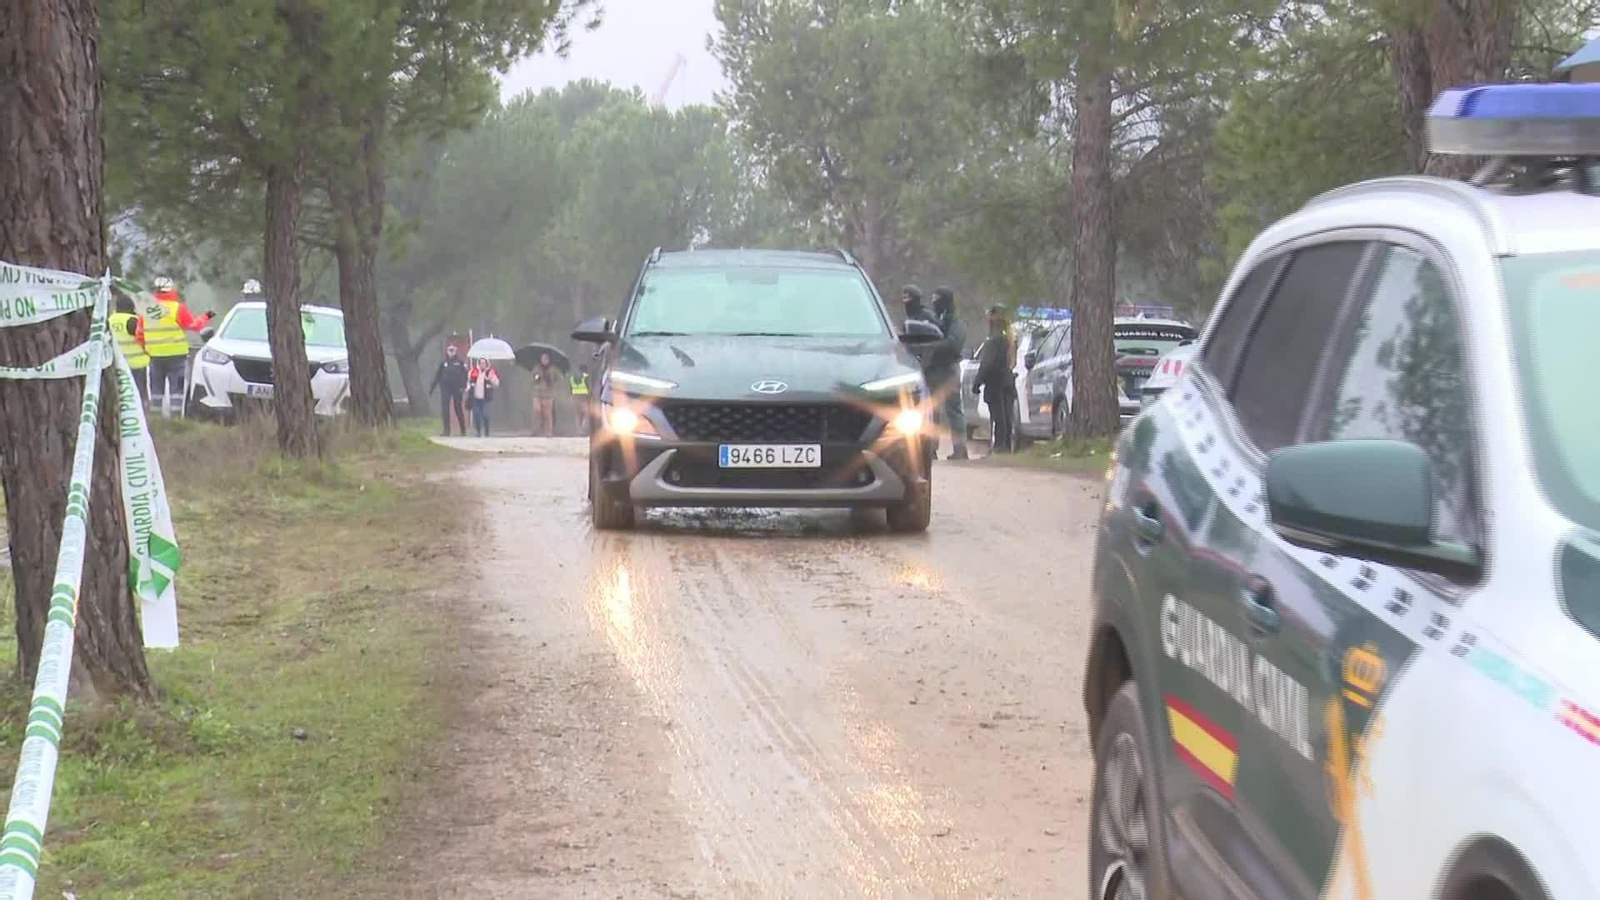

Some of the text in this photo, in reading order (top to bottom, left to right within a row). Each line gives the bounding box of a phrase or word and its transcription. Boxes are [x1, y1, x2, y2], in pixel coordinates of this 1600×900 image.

[0, 266, 21, 284] CIV
[15, 296, 36, 318] NO
[121, 417, 141, 437] NO
[730, 447, 816, 464] 9466 LZC
[127, 452, 148, 487] CIVIL
[1161, 594, 1314, 761] GUARDIA CIVIL
